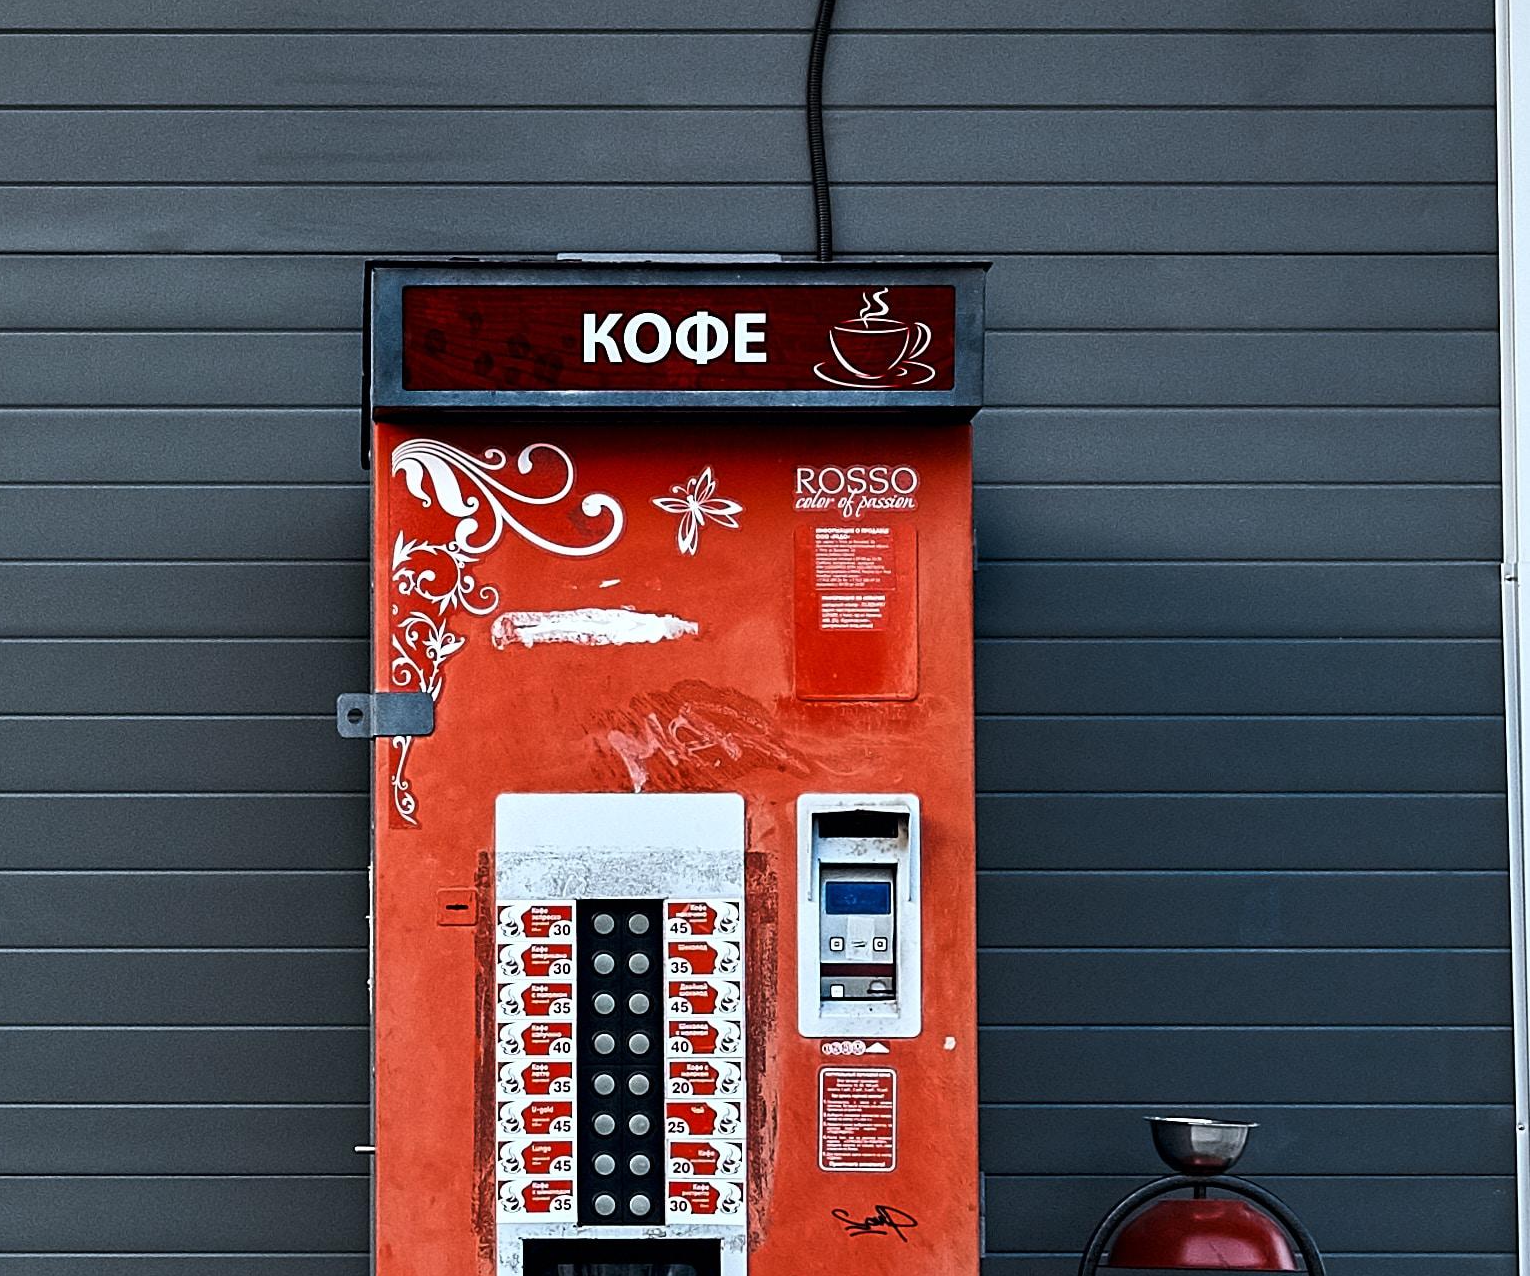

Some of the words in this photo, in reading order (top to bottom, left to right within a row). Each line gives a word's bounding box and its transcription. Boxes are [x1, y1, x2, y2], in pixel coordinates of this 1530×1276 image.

[583, 311, 767, 365] КОФЕ
[795, 467, 918, 495] ROSSO
[795, 488, 835, 509] color
[837, 488, 855, 518] of
[855, 494, 916, 518] passion
[553, 924, 571, 936] 30
[670, 922, 688, 934] 45
[553, 963, 571, 975] 30
[670, 961, 689, 974] 35
[553, 1001, 571, 1014] 35
[670, 1001, 689, 1013] 45
[553, 1041, 571, 1054] 40
[670, 1041, 689, 1053] 40
[553, 1081, 571, 1093] 35
[672, 1081, 690, 1094] 20
[553, 1120, 571, 1132] 45
[667, 1121, 685, 1134] 25
[553, 1160, 572, 1172] 45
[672, 1162, 691, 1174] 20
[554, 1199, 572, 1211] 35
[670, 1200, 688, 1212] 30
